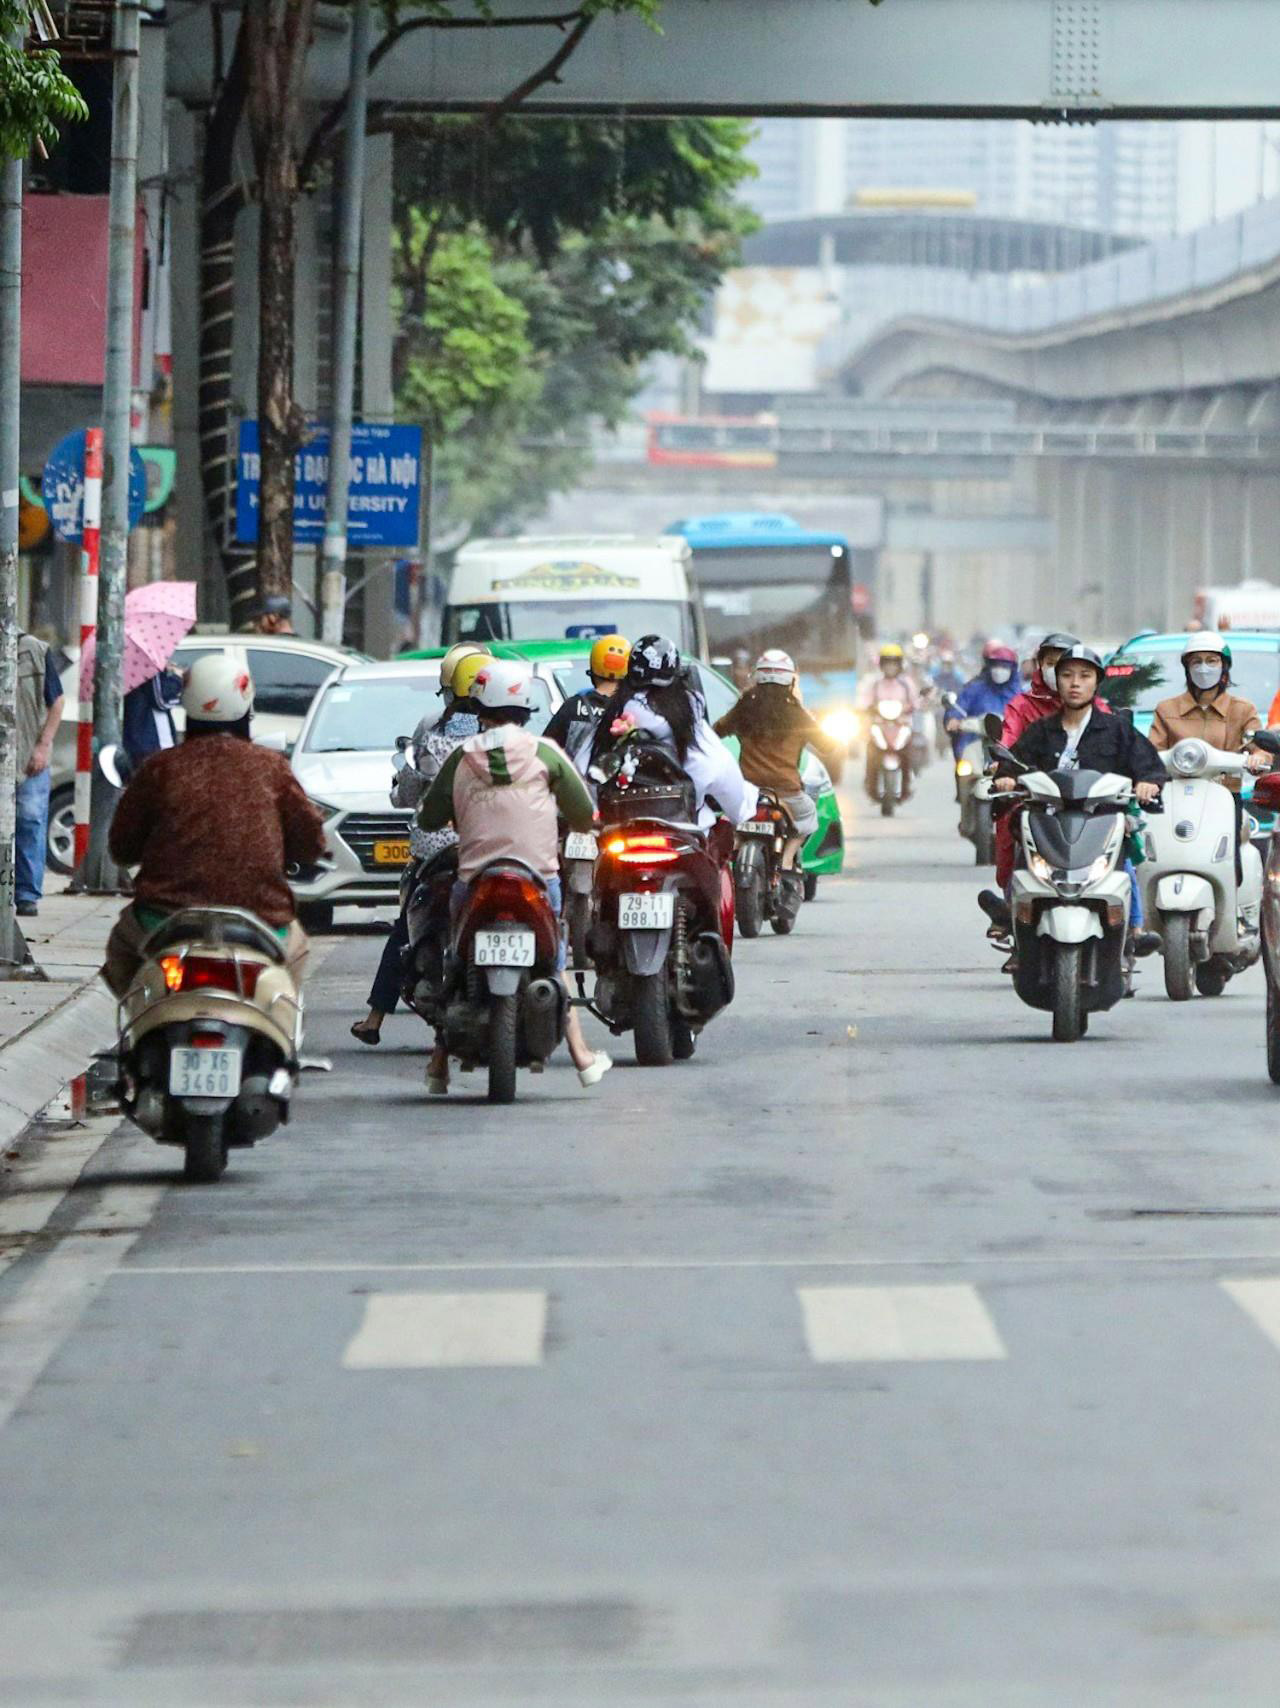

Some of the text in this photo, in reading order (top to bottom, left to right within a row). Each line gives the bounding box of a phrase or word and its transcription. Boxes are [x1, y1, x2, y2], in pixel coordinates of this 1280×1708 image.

[367, 451, 387, 485] HÀ
[390, 452, 418, 490] NỘI
[627, 896, 665, 911] 29-T1
[622, 911, 669, 926] 988.11
[485, 934, 524, 948] 19-C1
[181, 1073, 229, 1093] 3460
